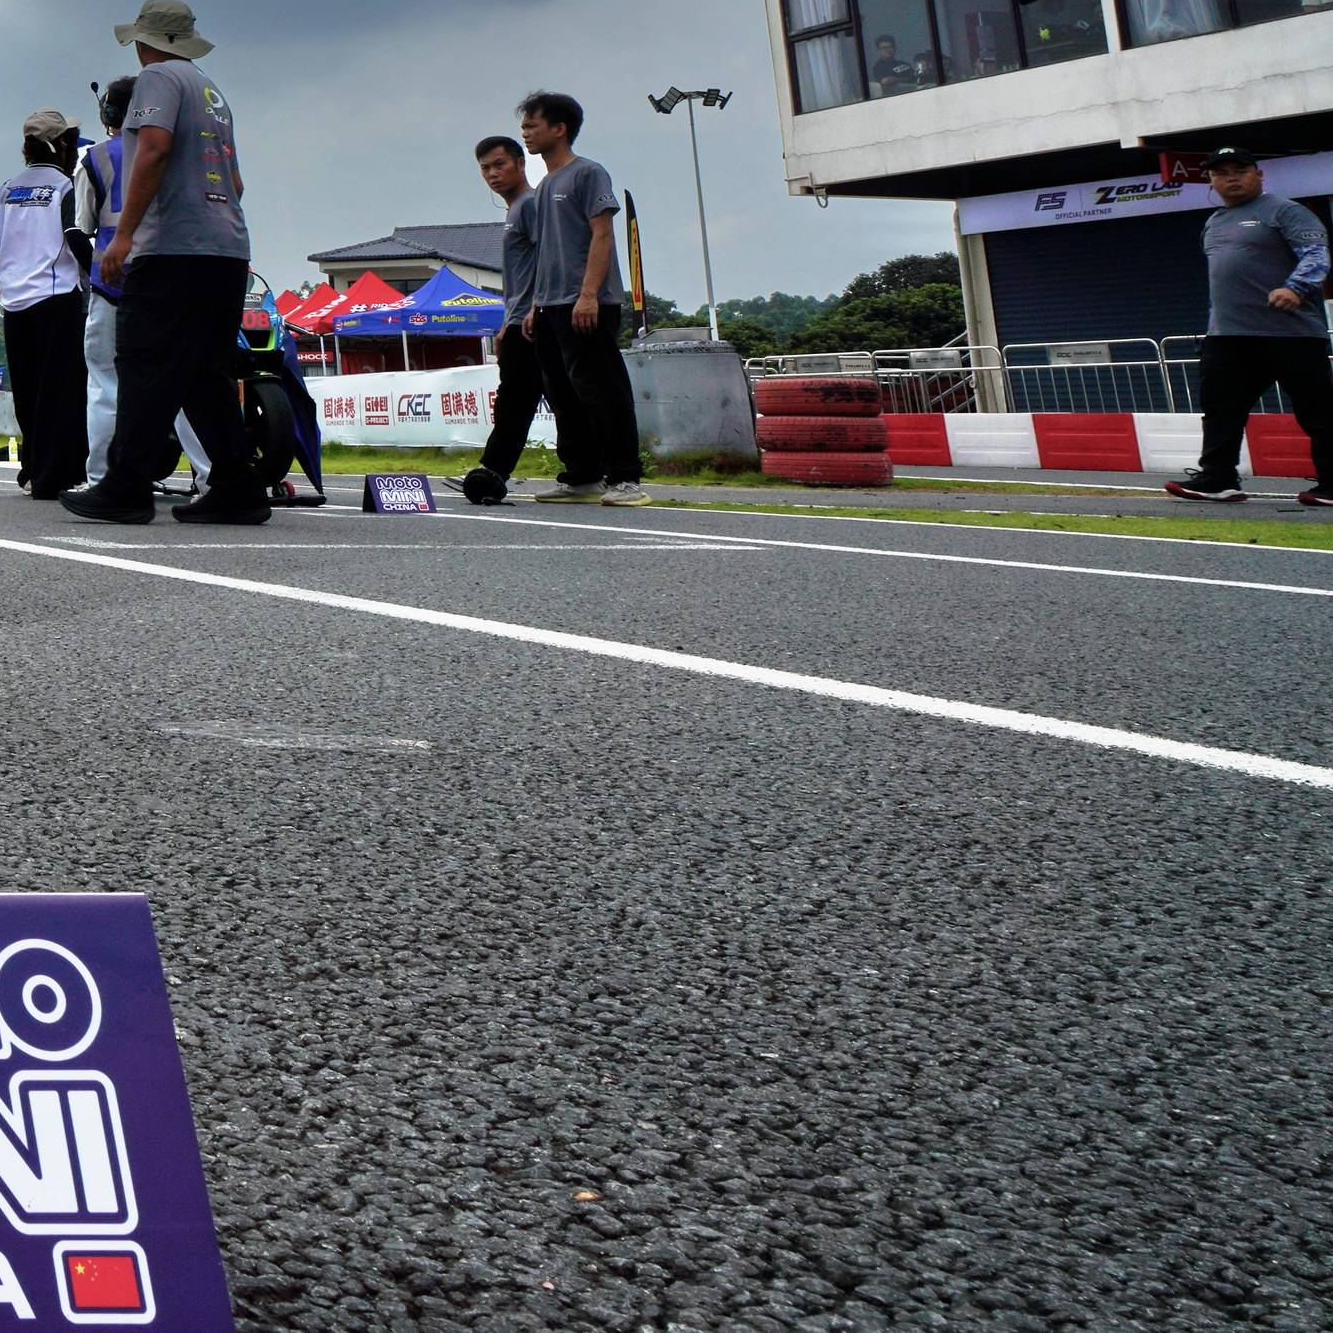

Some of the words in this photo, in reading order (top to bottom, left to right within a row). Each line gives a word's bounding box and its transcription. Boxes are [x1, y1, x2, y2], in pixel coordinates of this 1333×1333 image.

[1117, 190, 1182, 203] MOTORSPORT
[1055, 211, 1083, 220] OFFICIAL
[1083, 207, 1113, 217] PARTNER
[243, 311, 270, 330] 08
[431, 315, 466, 323] Putoline
[398, 394, 431, 416] CKEC
[375, 476, 423, 490] Moto
[379, 489, 428, 504] MINI
[383, 503, 418, 511] CHINA
